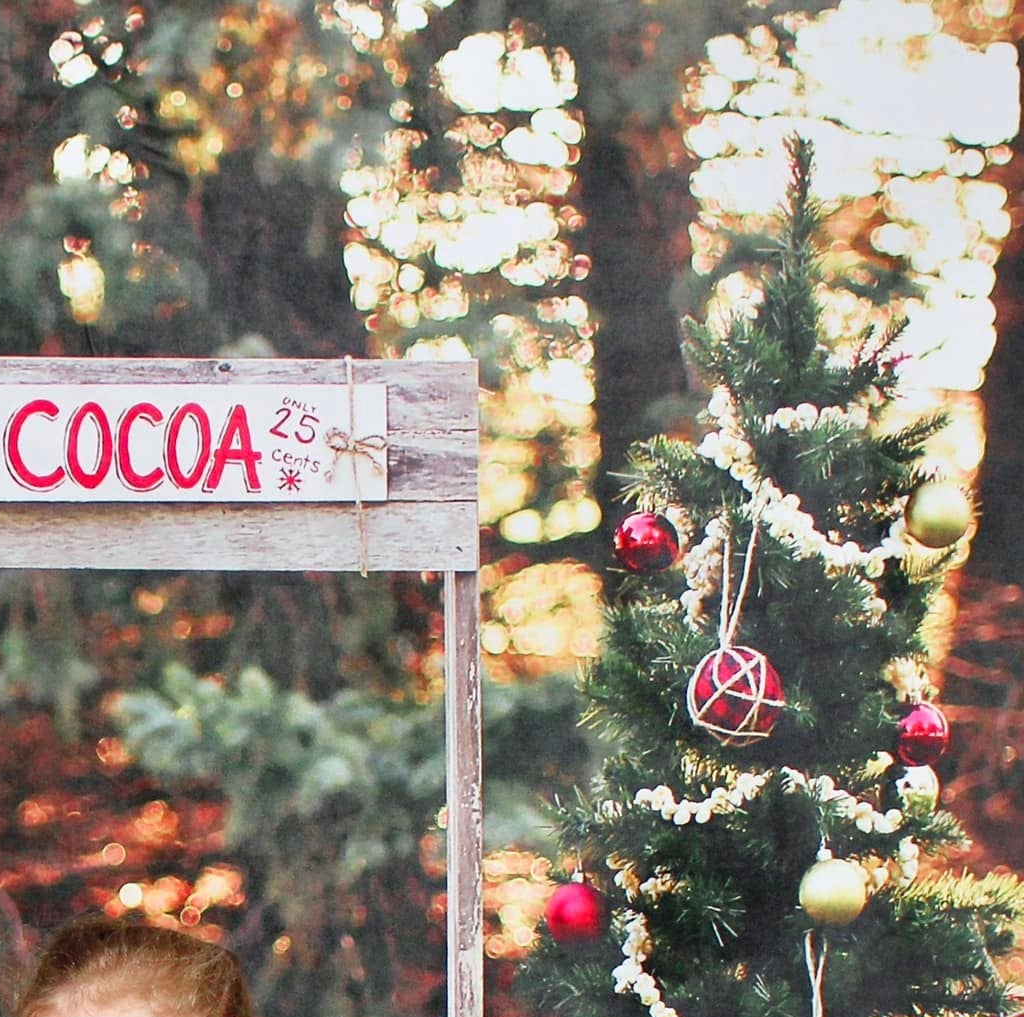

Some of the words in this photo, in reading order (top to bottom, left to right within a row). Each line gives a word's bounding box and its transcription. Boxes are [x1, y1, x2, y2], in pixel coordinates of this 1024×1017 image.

[282, 396, 317, 413] ONLY
[269, 408, 320, 443] 25
[3, 399, 262, 493] COCOA
[271, 448, 321, 473] cents
